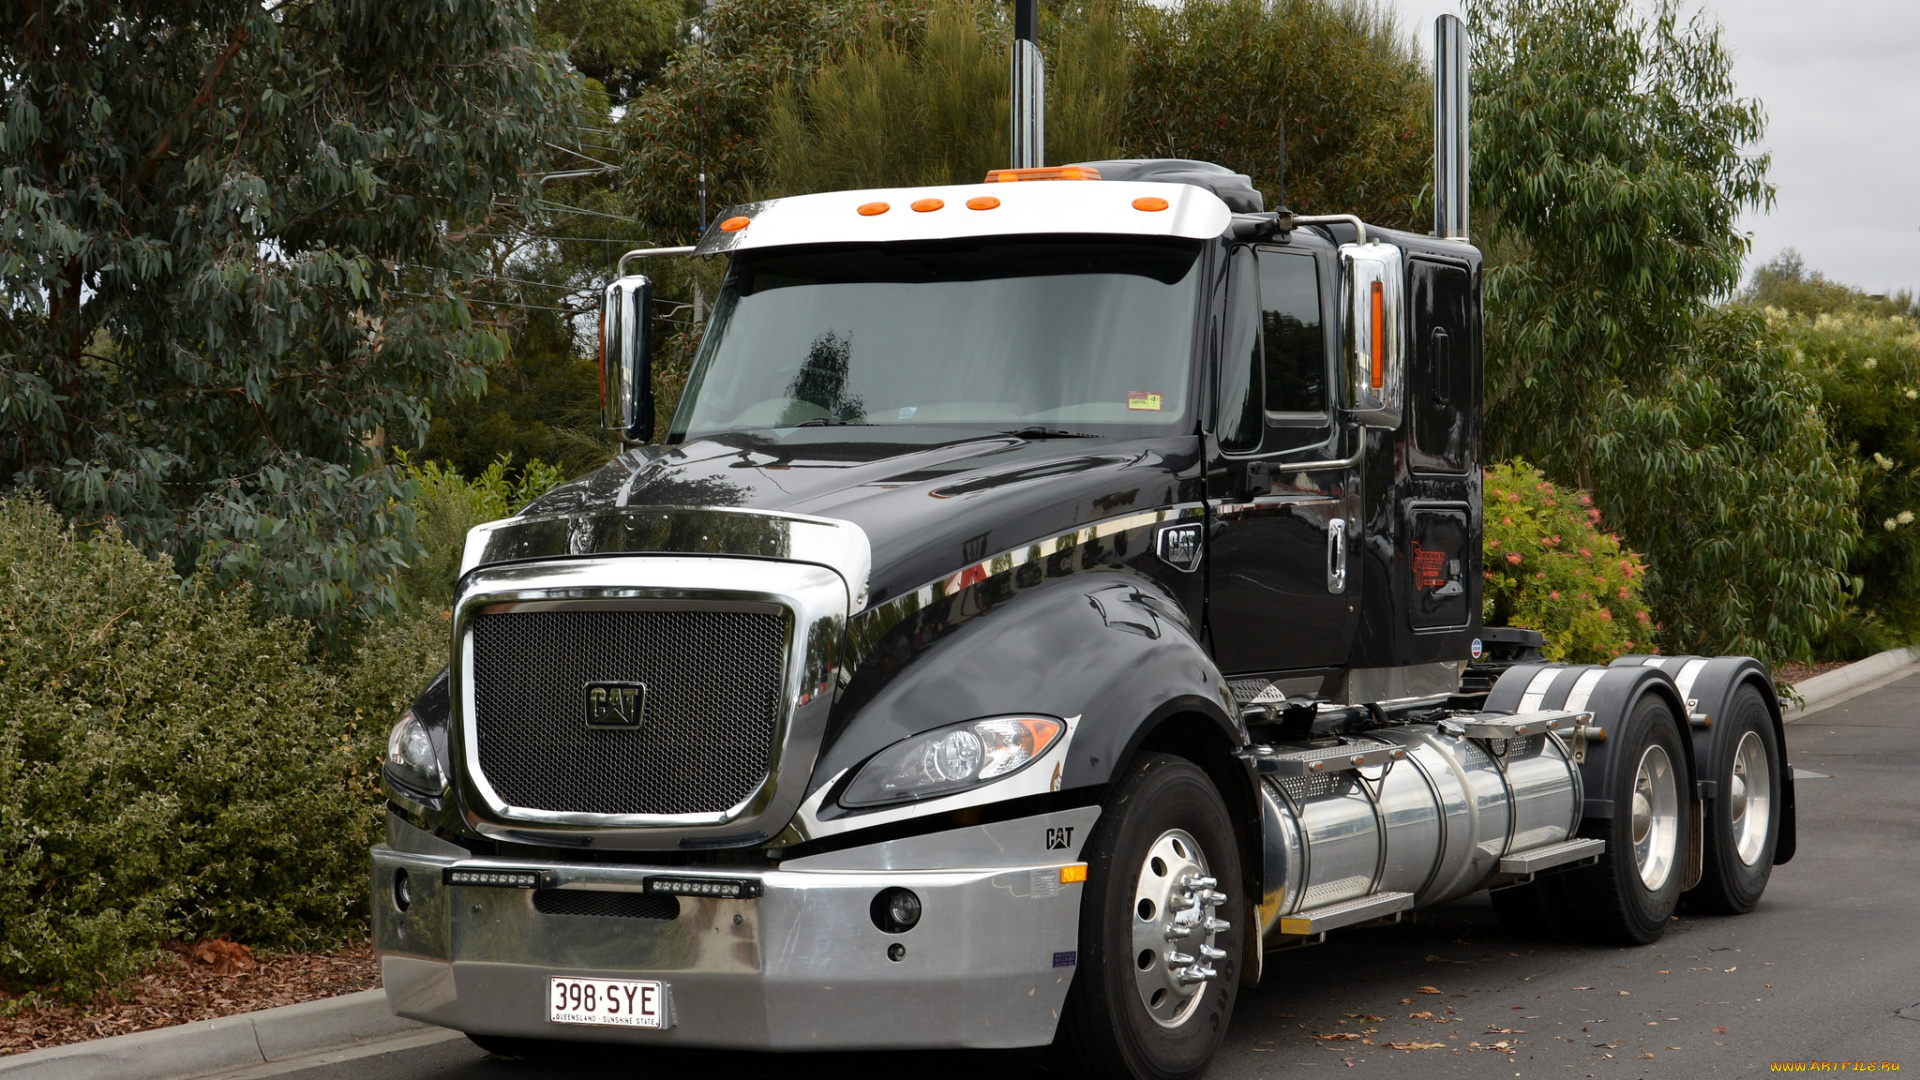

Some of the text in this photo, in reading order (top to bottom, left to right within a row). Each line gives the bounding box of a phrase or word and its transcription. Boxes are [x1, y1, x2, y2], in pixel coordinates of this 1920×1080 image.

[1168, 530, 1196, 562] CAT
[590, 687, 639, 723] CAT
[1046, 826, 1075, 850] CAT
[555, 1013, 655, 1026] QUEENSLAND SUNSHINE STATE
